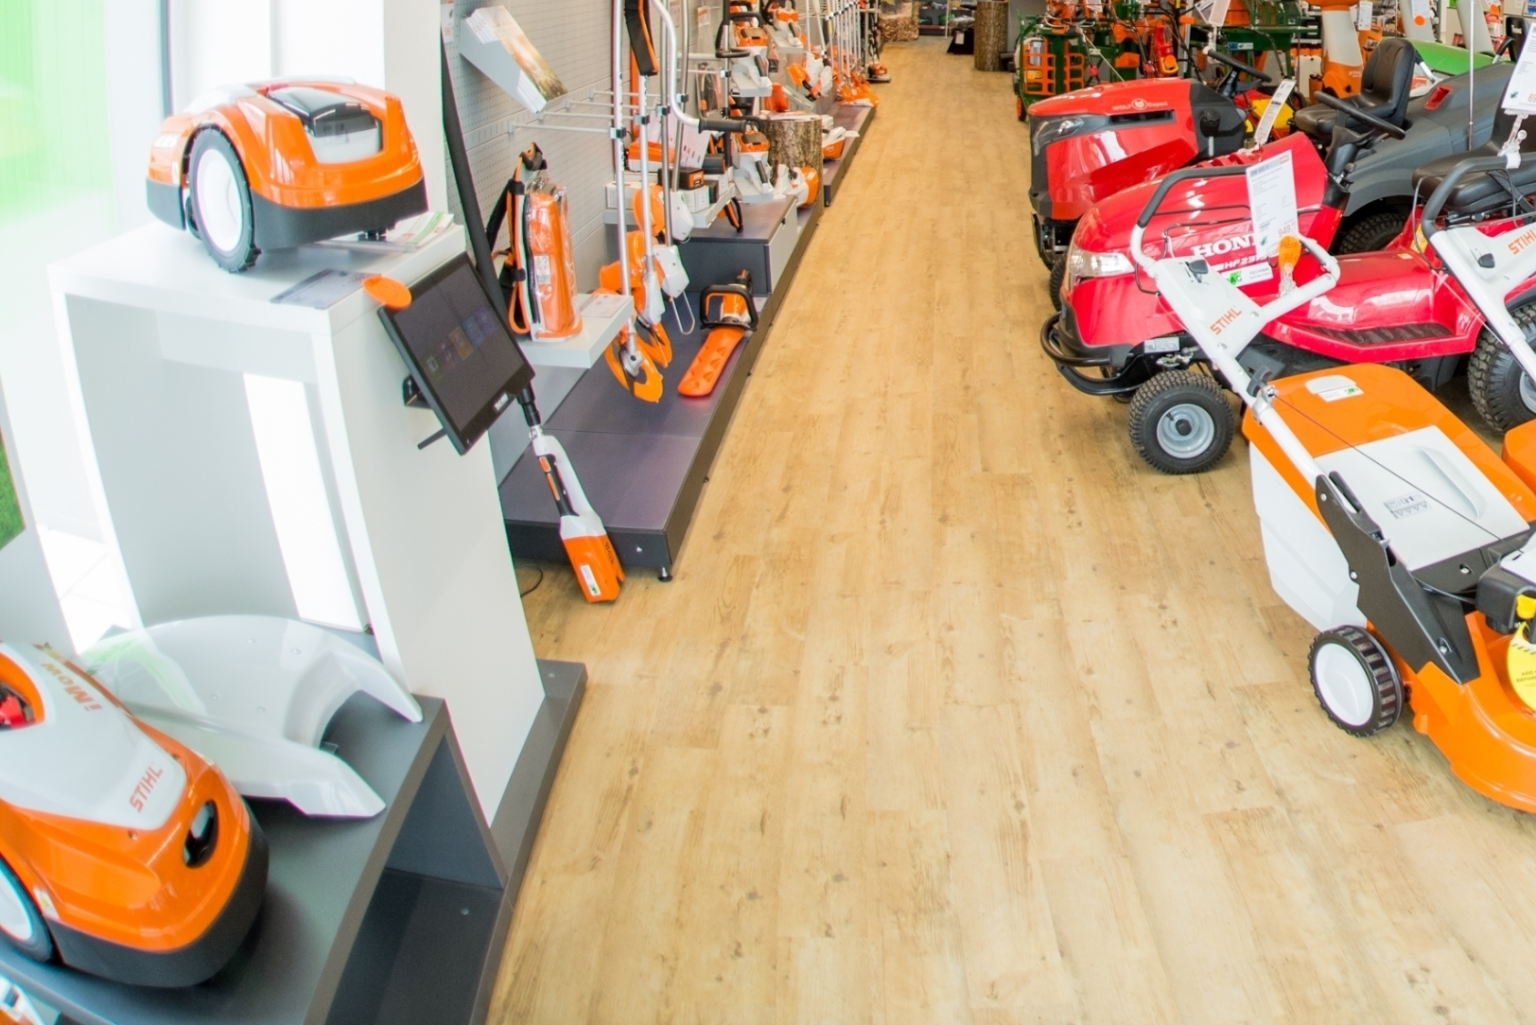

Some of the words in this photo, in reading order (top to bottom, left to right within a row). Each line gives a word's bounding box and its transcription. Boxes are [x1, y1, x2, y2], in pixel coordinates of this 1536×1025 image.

[1190, 233, 1256, 258] HON
[1209, 307, 1243, 335] STIHL
[129, 766, 164, 813] STIHL
